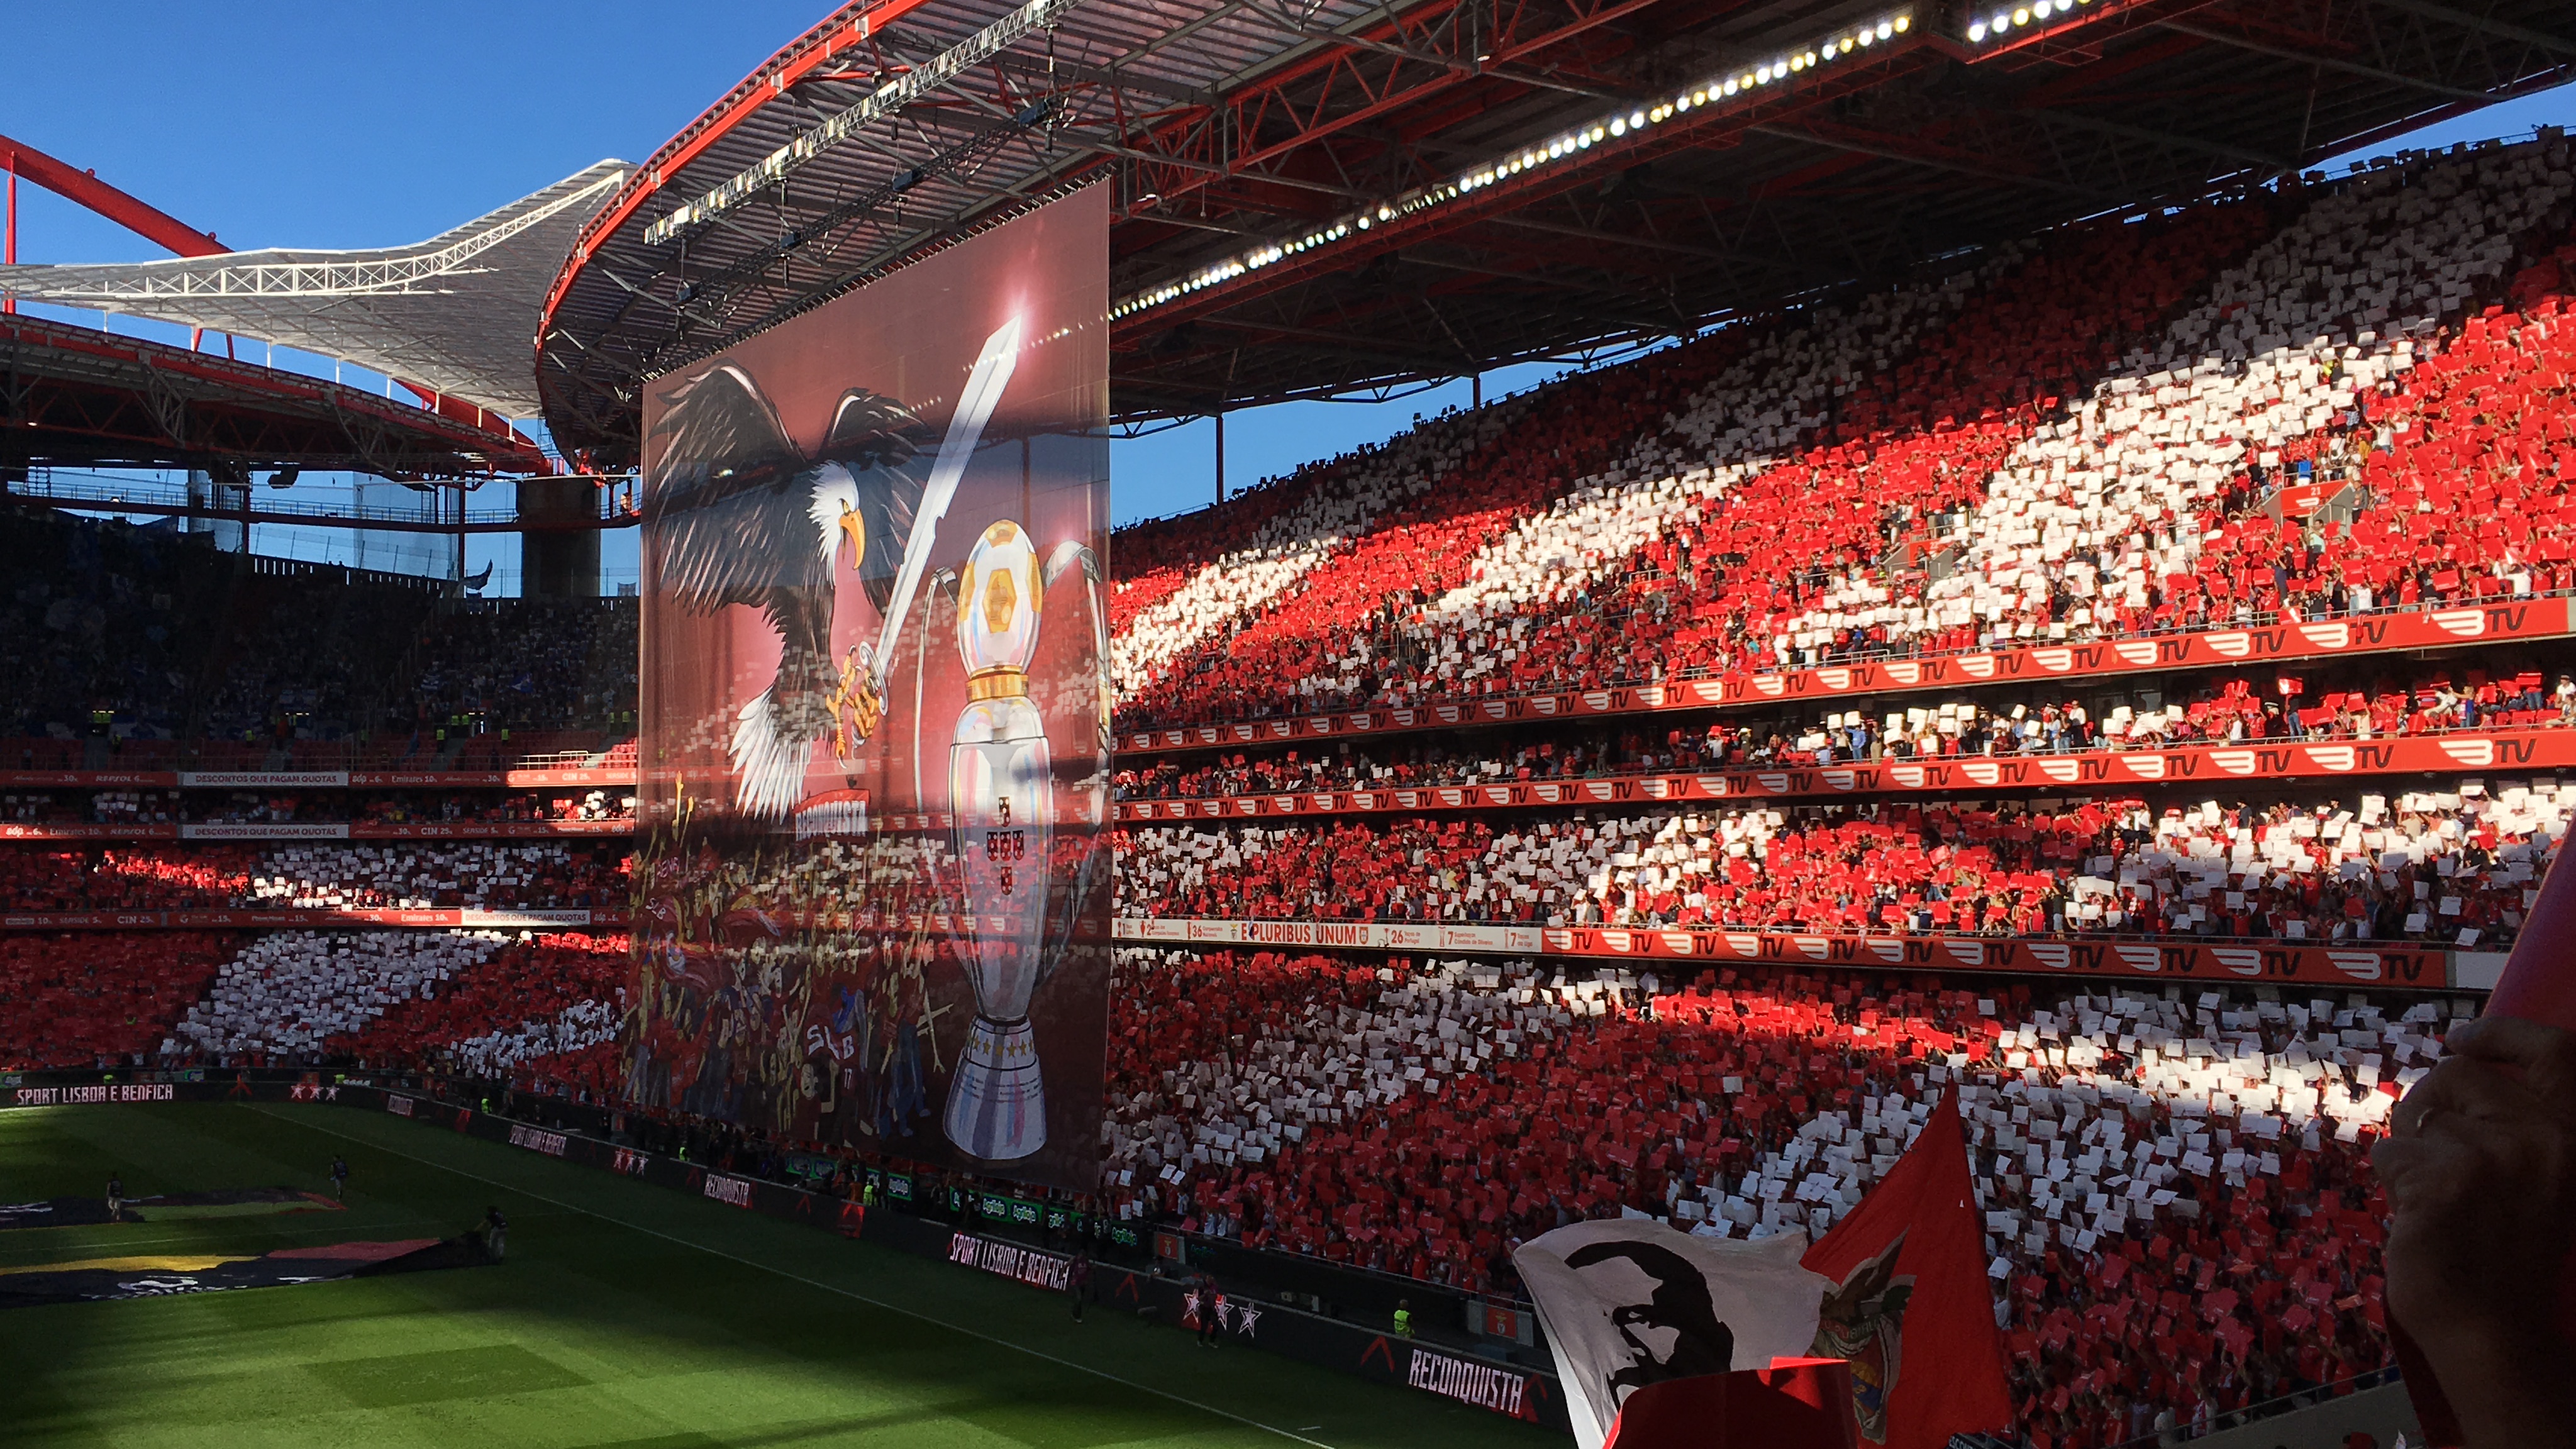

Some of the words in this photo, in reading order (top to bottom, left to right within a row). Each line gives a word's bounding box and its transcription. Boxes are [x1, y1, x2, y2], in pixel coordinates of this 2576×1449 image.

[511, 914, 527, 922] QUE
[1192, 925, 1202, 938] 36
[1241, 923, 1247, 940] E
[1252, 923, 1311, 943] PLURIBUS
[1316, 924, 1357, 945] UNUM
[1391, 930, 1403, 944] 26
[1448, 931, 1453, 945] 7
[1511, 933, 1516, 947] 7
[807, 1024, 855, 1060] SLB
[17, 1088, 58, 1106] SPORT
[63, 1086, 105, 1103] LISBOA
[111, 1085, 118, 1101] E
[122, 1084, 173, 1101] BENFICA
[950, 1233, 983, 1265] SPORT
[981, 1241, 1016, 1277] LISBOA
[1016, 1251, 1026, 1279] E
[1025, 1252, 1070, 1291] BENFICA
[1408, 1348, 1524, 1414] RECONQUISTA
